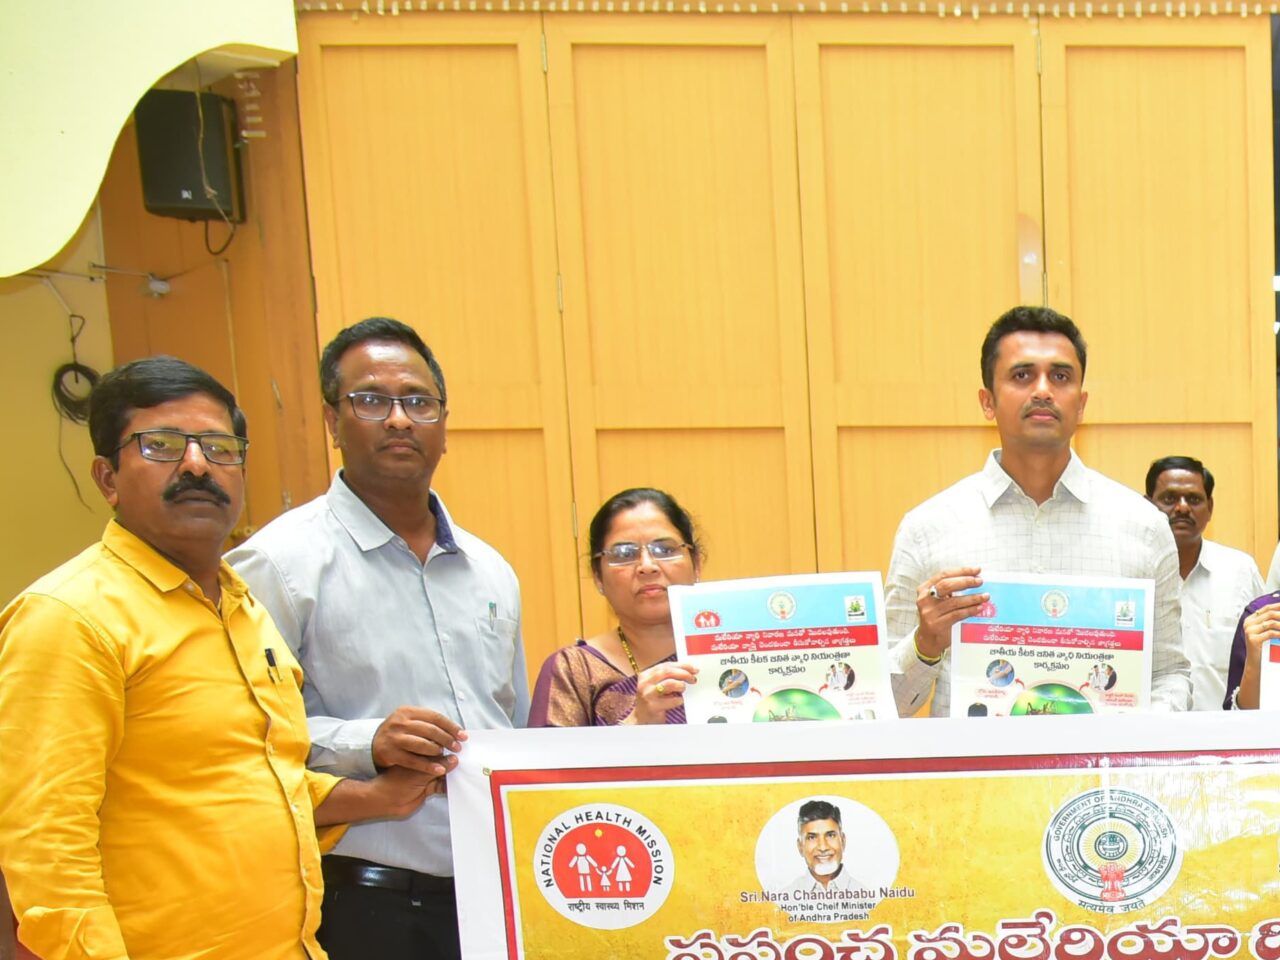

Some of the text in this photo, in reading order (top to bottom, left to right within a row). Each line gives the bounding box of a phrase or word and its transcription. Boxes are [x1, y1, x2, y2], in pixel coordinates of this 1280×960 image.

[1054, 797, 1091, 841] GOVERNMENT
[1094, 795, 1106, 803] OF
[541, 811, 663, 887] NATIONAL HEALTH MISSION
[793, 888, 875, 901] Chandrababu
[880, 887, 915, 898] Naidu
[568, 900, 590, 912] राष्ट्रीय
[817, 902, 839, 911] Cheif
[800, 914, 831, 922] Andhra
[834, 913, 869, 921] Pradesh
